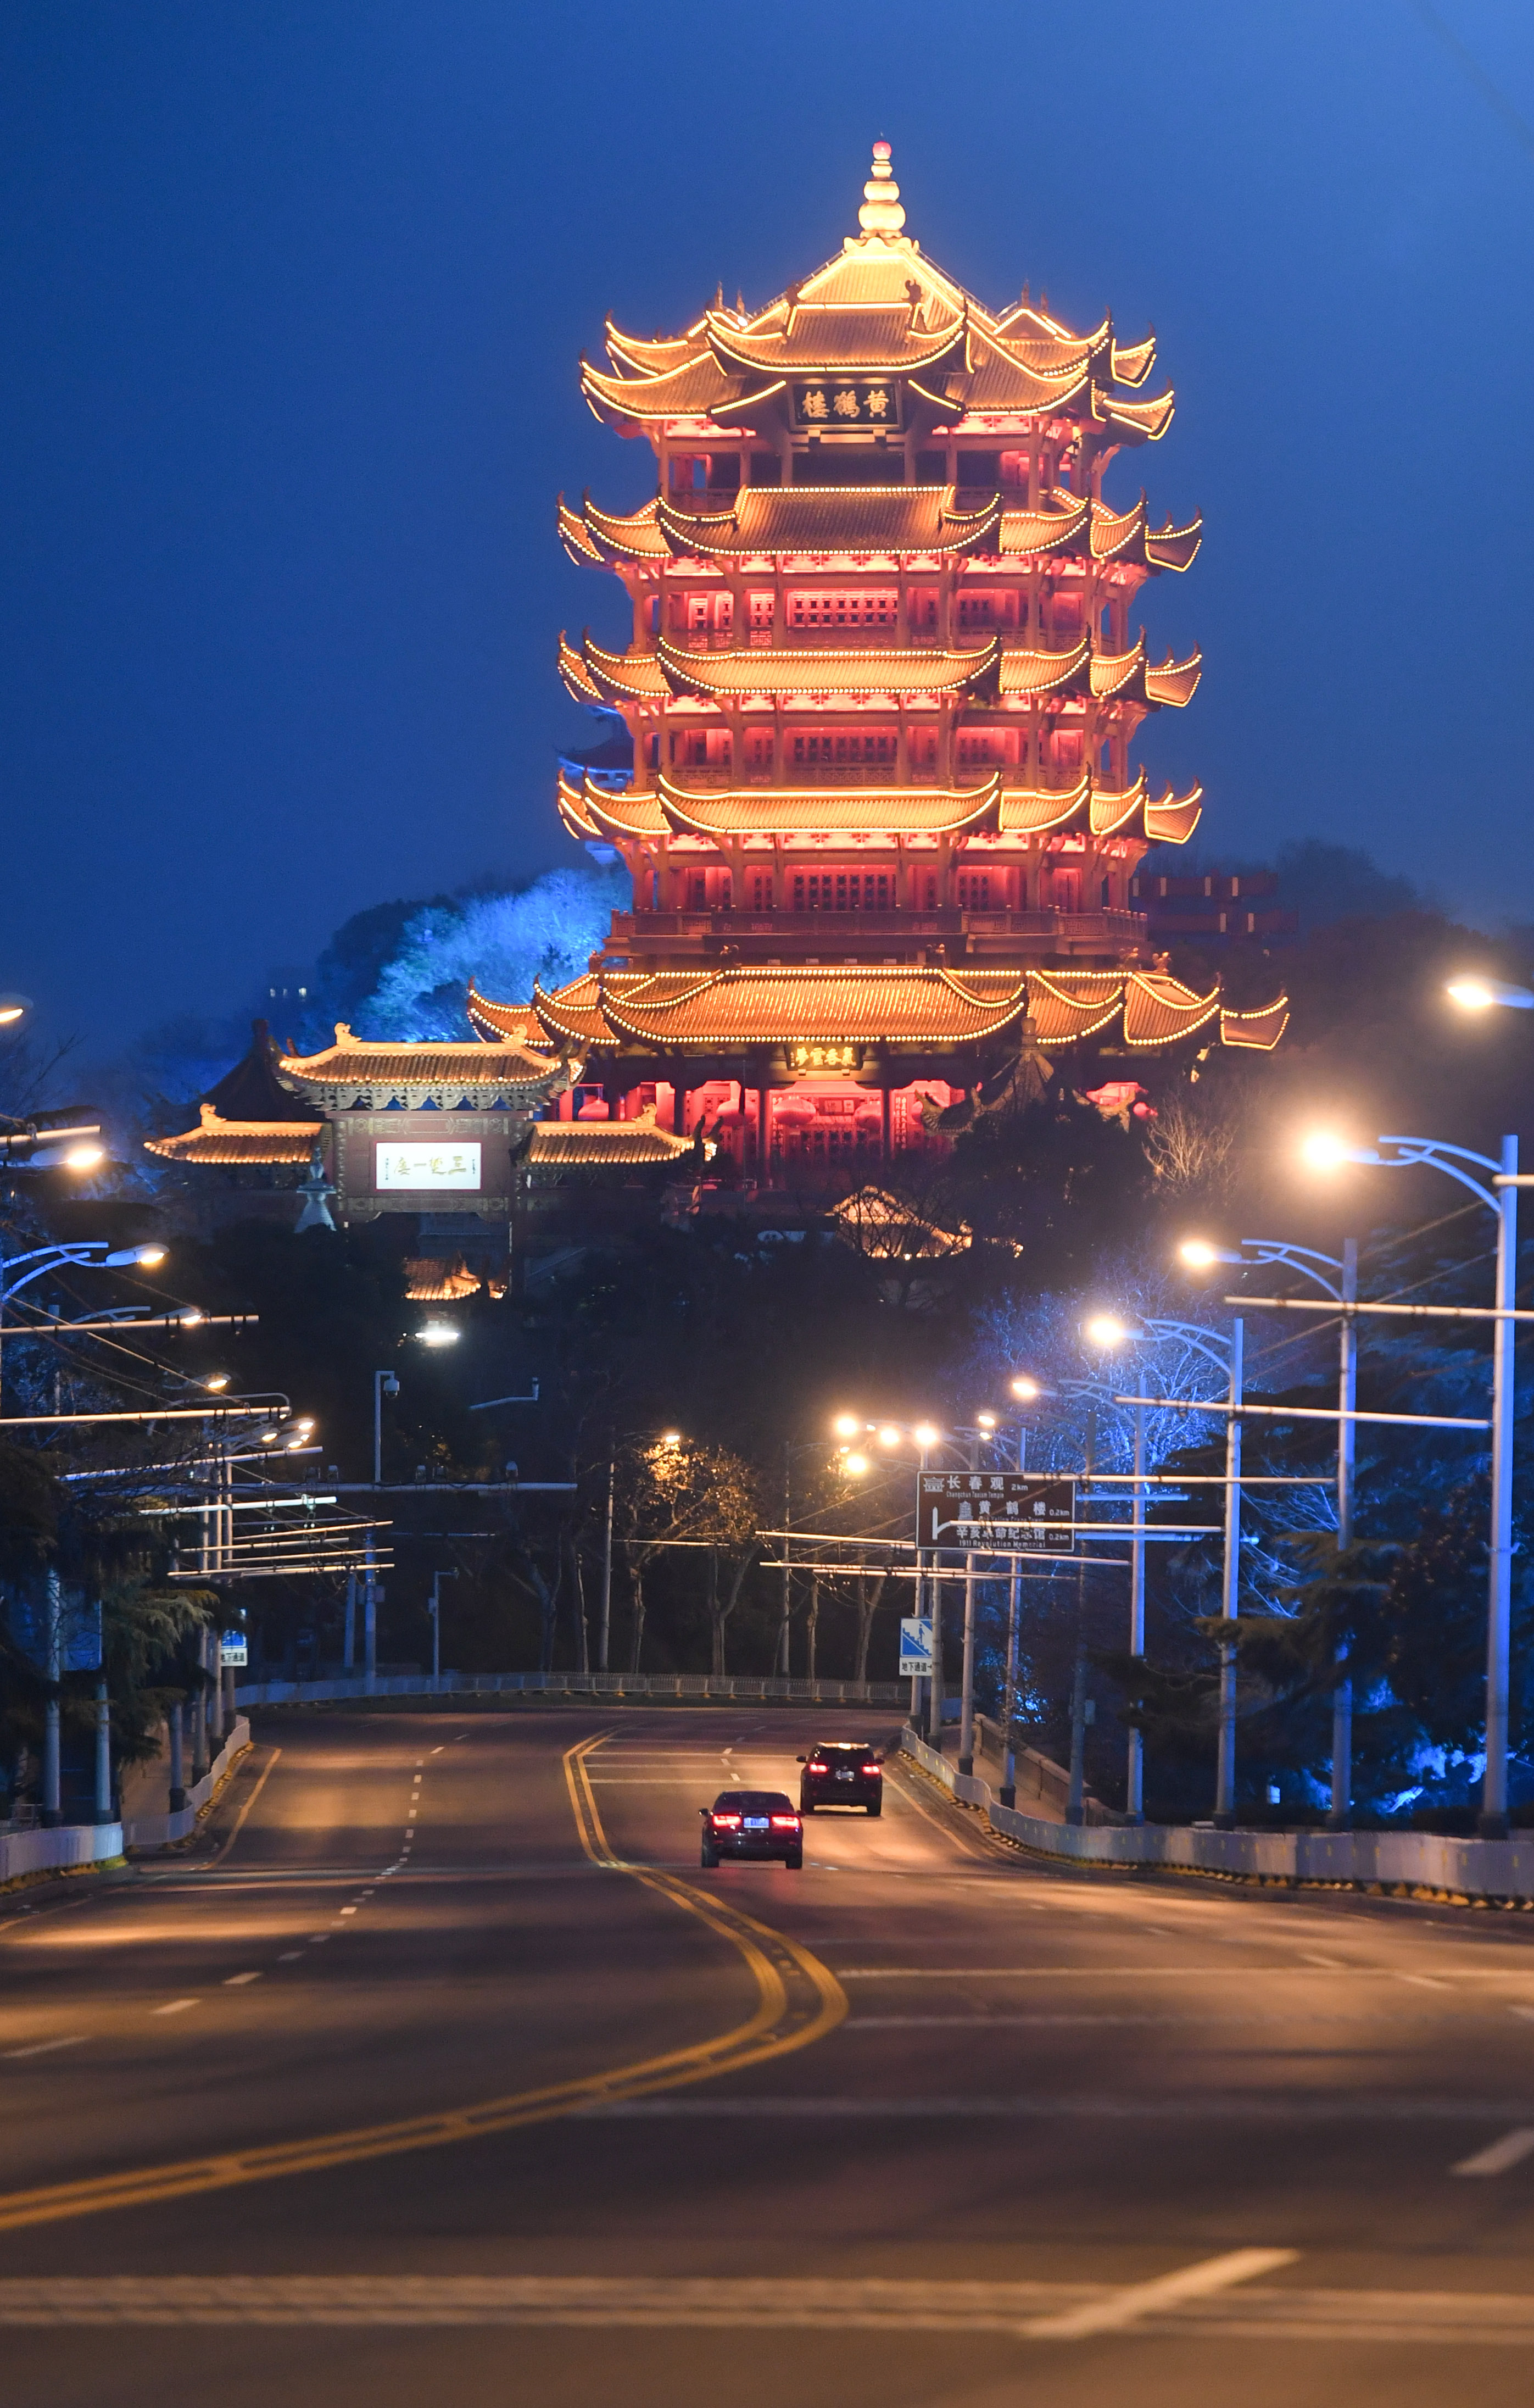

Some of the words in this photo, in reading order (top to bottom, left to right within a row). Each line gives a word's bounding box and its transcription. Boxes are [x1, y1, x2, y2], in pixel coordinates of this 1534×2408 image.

[947, 1475, 1005, 1490] 长春观
[979, 1500, 1046, 1516] 黄鹤楼
[902, 1661, 927, 1672] 地下通道
